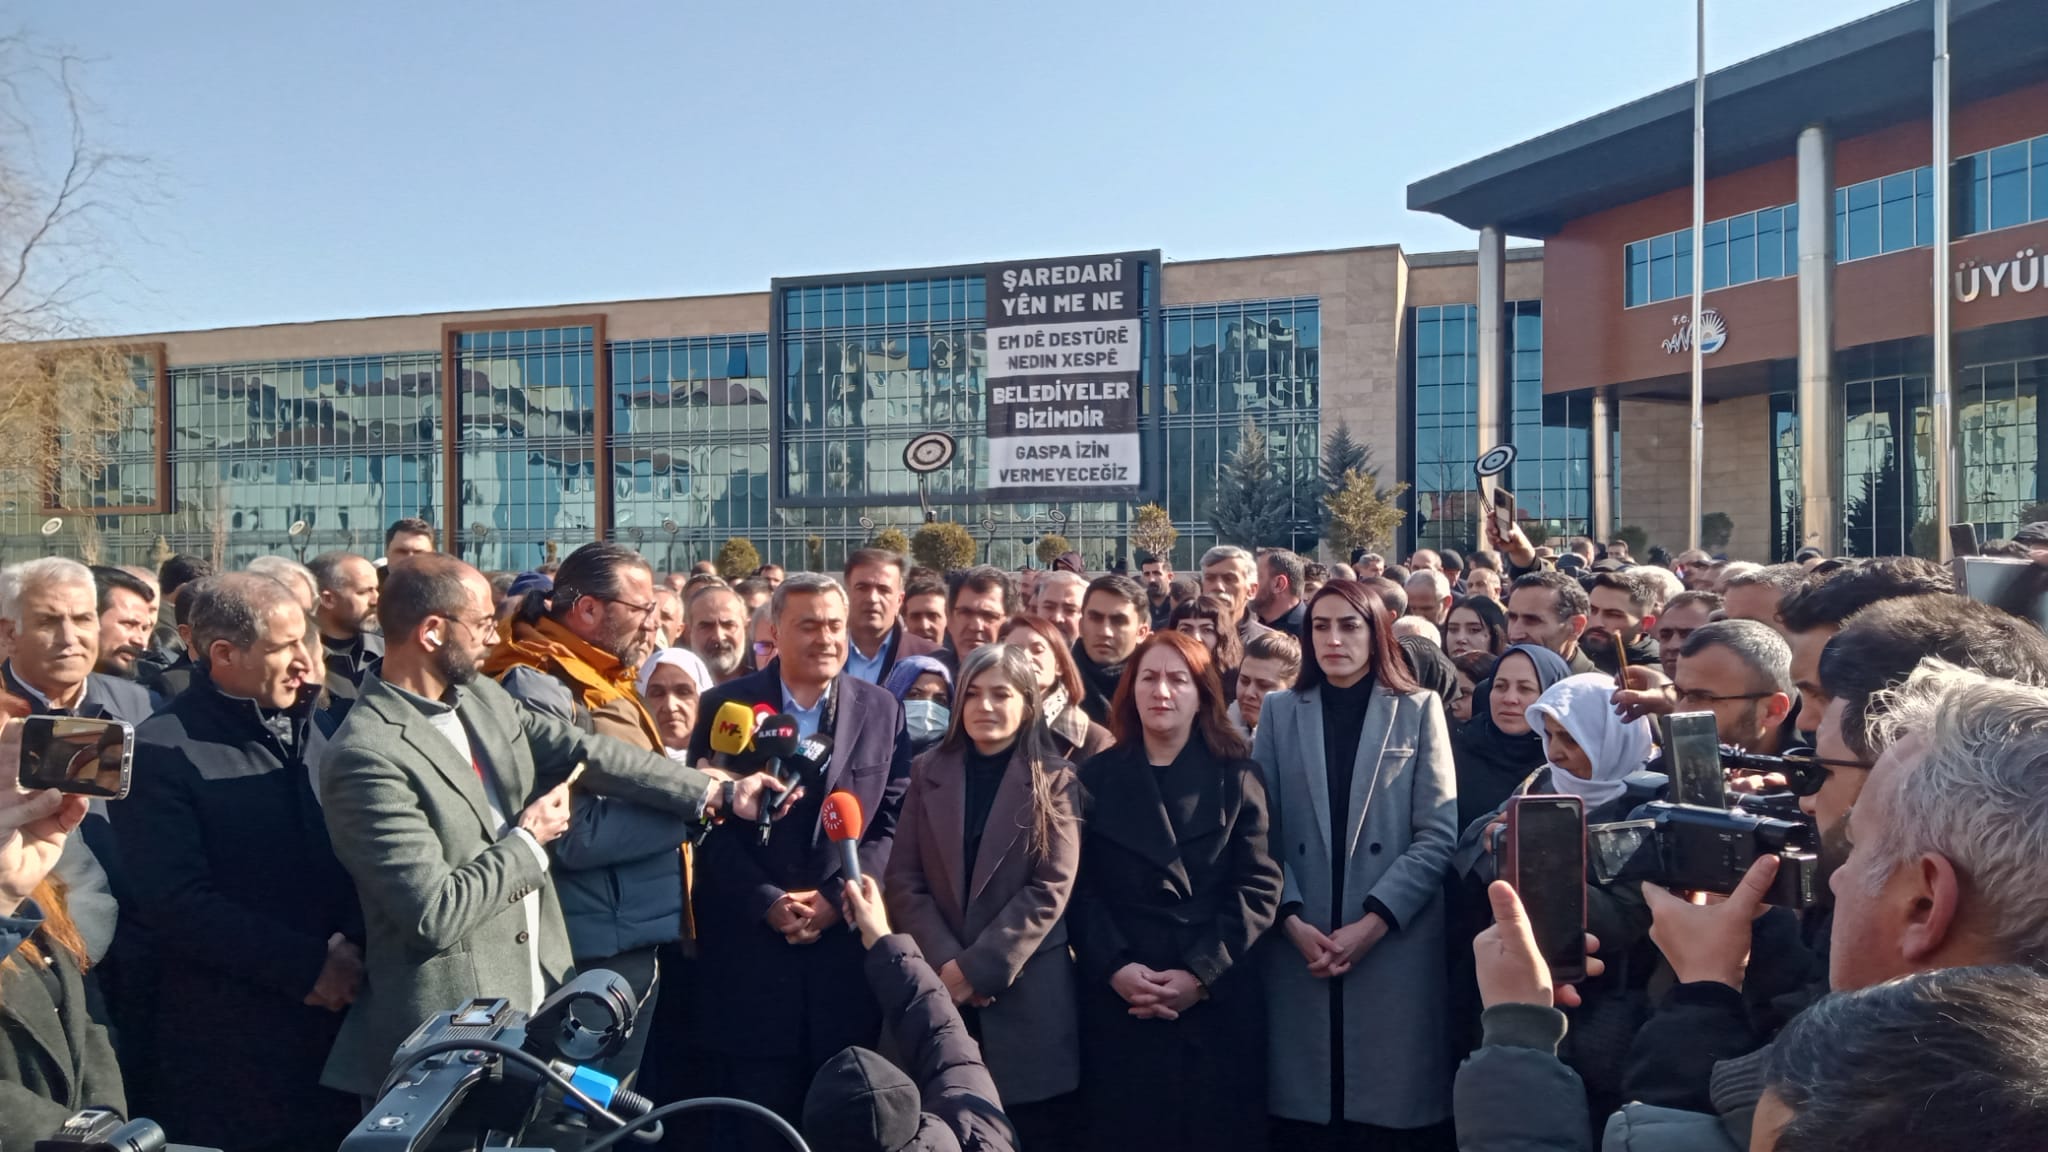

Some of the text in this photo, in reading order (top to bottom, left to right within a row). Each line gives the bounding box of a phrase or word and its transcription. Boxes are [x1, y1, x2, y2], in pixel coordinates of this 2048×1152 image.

[1002, 258, 1124, 292] ŞAREDARÎ
[1954, 248, 2048, 302] ÜYÜ
[1002, 291, 1124, 316] YÊN ME NE
[998, 326, 1129, 350] EM DÊ DESTÛRÊ
[1008, 348, 1118, 370] NEDIN XESPÊ
[993, 380, 1130, 404] BELEDİYELER
[1015, 405, 1104, 429] BİZİMDİR
[1016, 440, 1109, 460] GASPA İZİN
[999, 463, 1128, 482] VERMEYECEĞİZ
